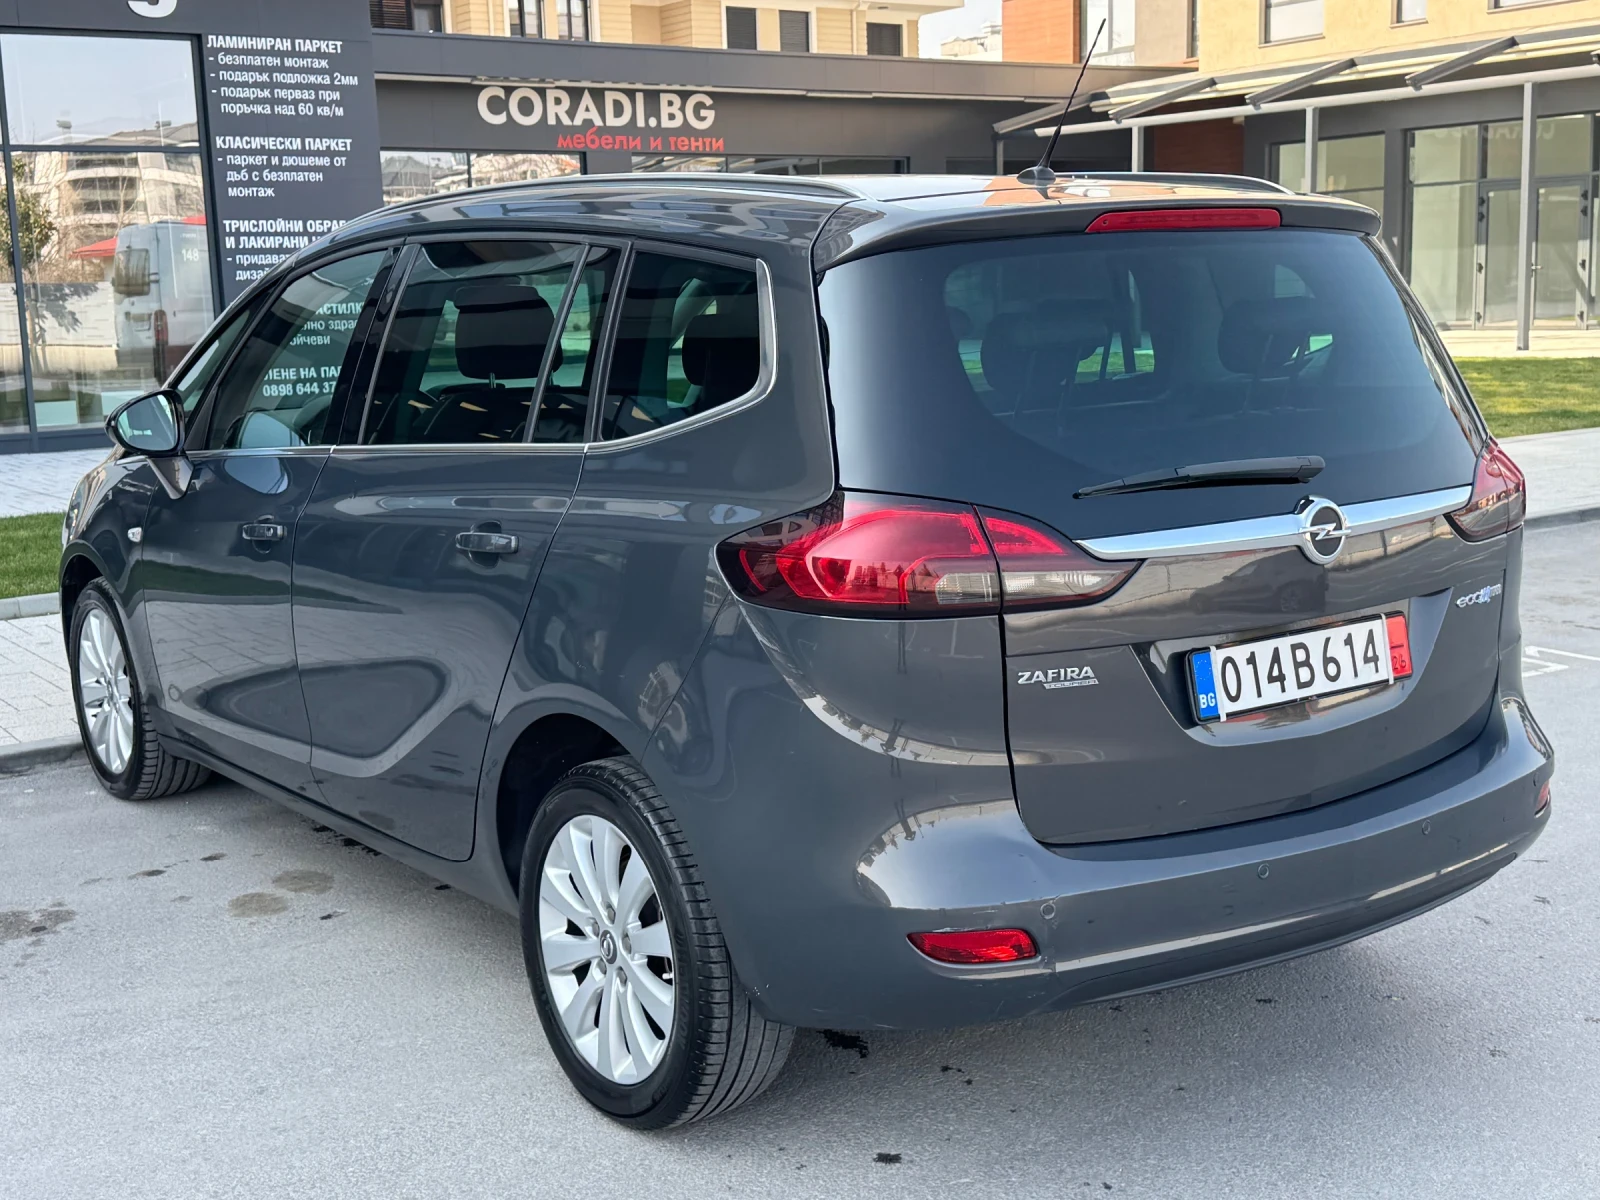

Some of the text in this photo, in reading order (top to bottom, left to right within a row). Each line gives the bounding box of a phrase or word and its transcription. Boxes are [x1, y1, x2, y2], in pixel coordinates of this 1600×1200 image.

[207, 35, 343, 54] ЛАМИНИРАН ПАРКЕТ
[218, 52, 329, 69] безплатен монтаж
[219, 70, 359, 86] подарък подложка 2мм
[220, 86, 341, 103] подарък перваз при
[220, 102, 344, 117] поръчка над 60 кв/м
[477, 86, 716, 130] CORADI.BG
[215, 135, 353, 152] КЛАСИЧЕСКИ ПАРКЕТ
[557, 126, 725, 152] мебели и тенти
[226, 154, 347, 168] паркет и дюшеме от
[251, 170, 260, 181] с
[262, 168, 323, 182] безплатен
[228, 186, 275, 197] монтаж
[222, 218, 304, 234] ТРИСЛОЙНИ
[225, 236, 236, 249] И
[238, 235, 309, 249] ЛАКИРАНИ
[181, 248, 199, 262] 148
[299, 366, 317, 379] НА
[262, 383, 294, 397] 0898
[295, 381, 320, 396] 644
[1220, 628, 1380, 704] 014B614
[1017, 665, 1095, 685] ZAFIRA
[1199, 692, 1216, 709] BG
